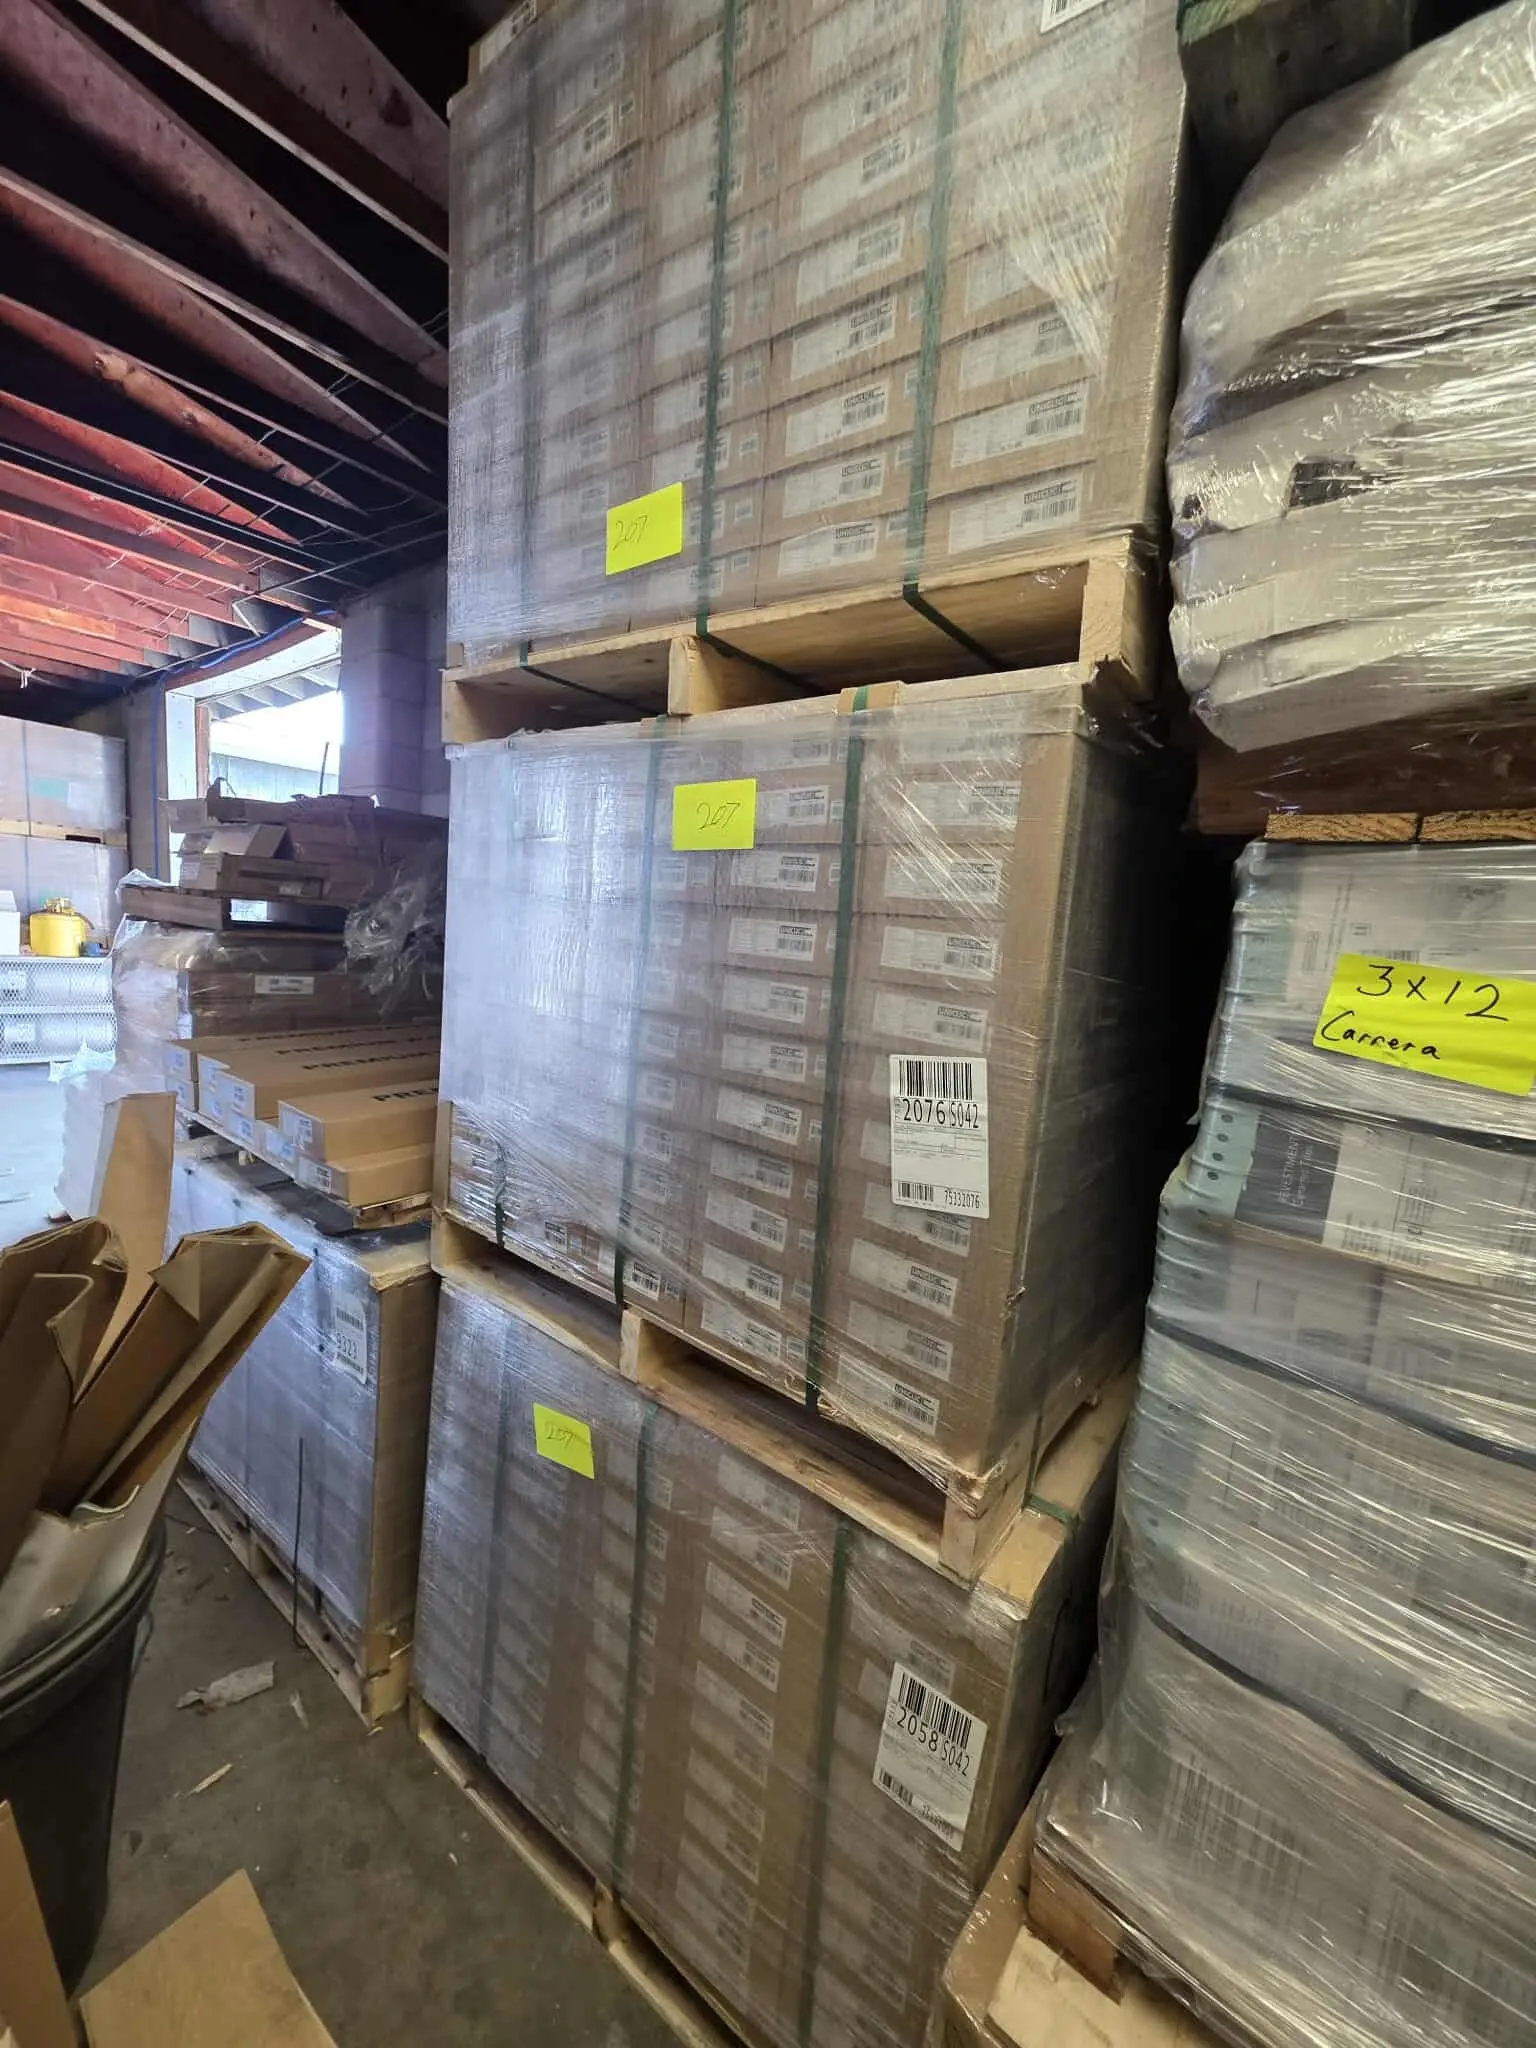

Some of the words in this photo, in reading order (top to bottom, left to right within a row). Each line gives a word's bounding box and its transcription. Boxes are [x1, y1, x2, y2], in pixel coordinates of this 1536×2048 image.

[612, 514, 648, 551] 207
[696, 800, 741, 830] 207
[1320, 1010, 1441, 1060] Carrera
[372, 1087, 438, 1101] PRE
[903, 1098, 946, 1125] 2076
[951, 1102, 979, 1129] S042
[944, 1190, 980, 1209] 75332076
[896, 1705, 938, 1752] 2058
[941, 1739, 970, 1777] S042
